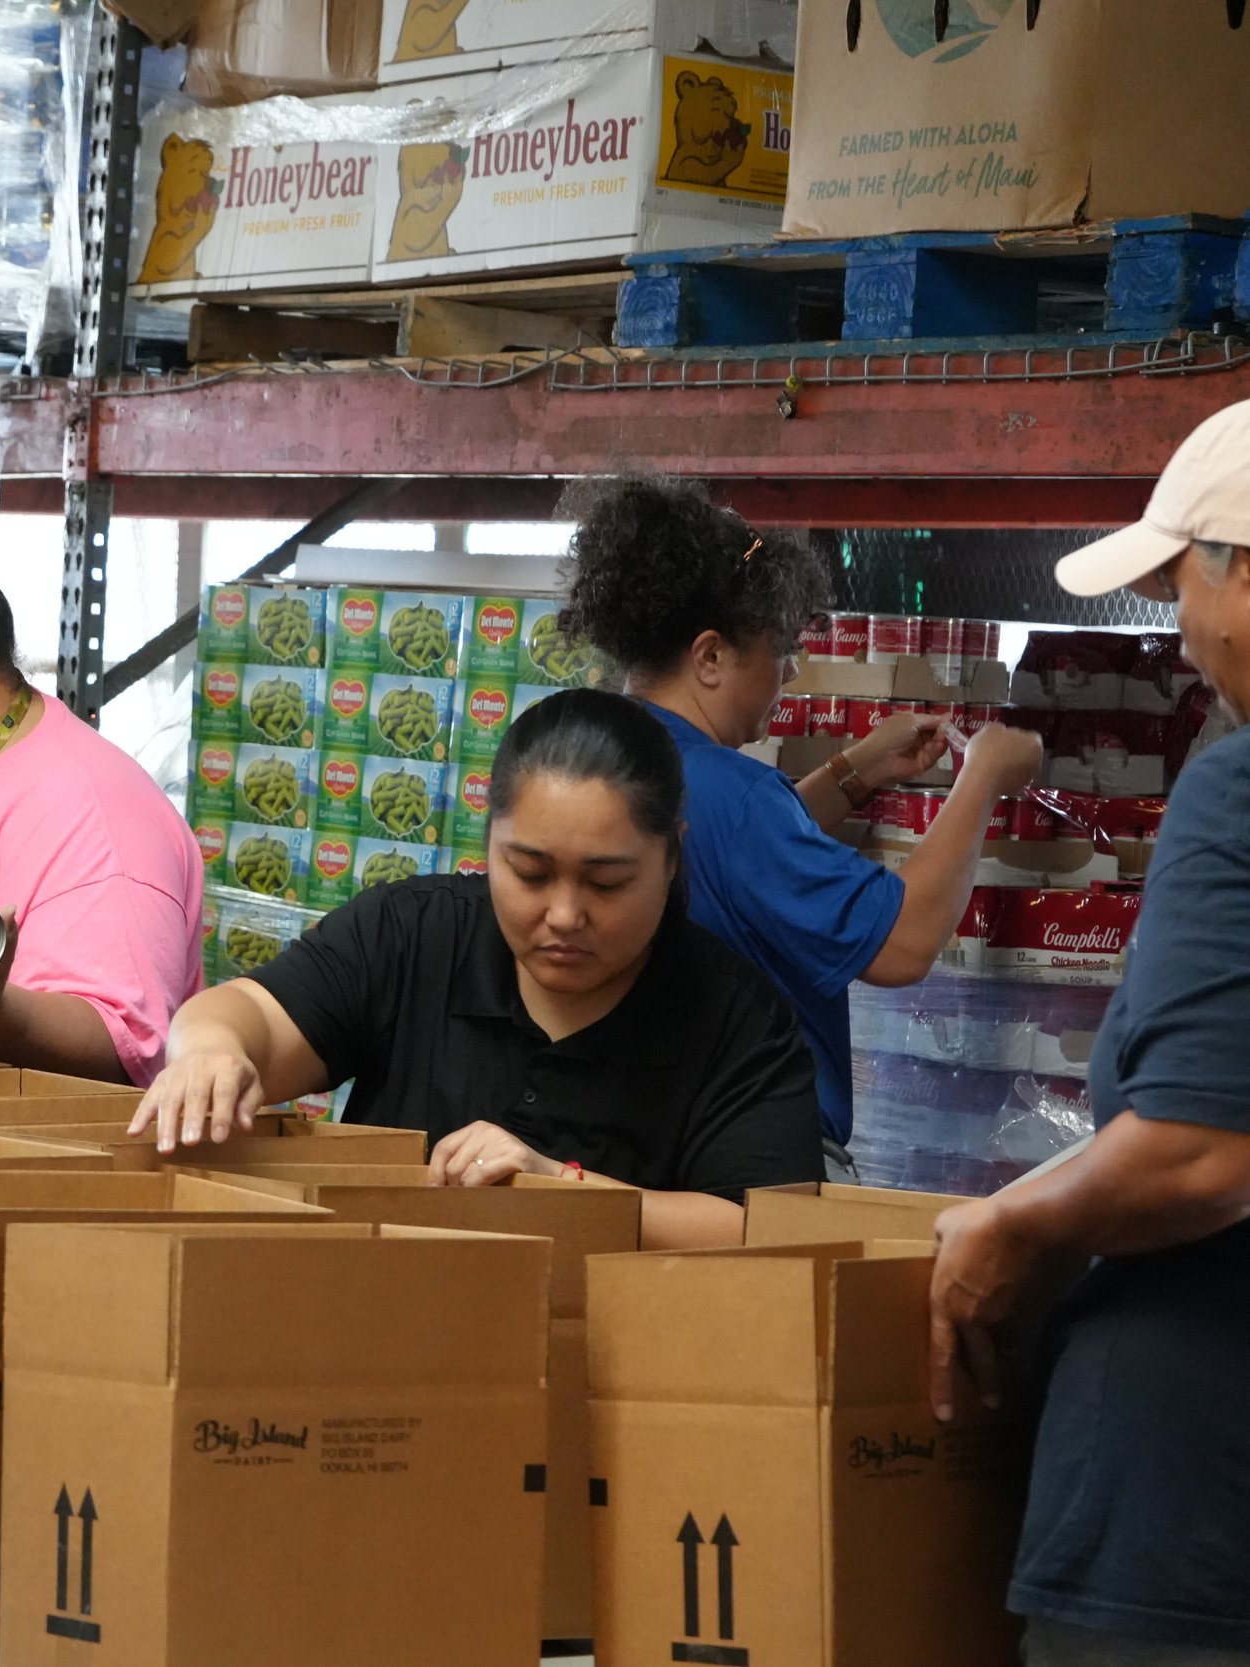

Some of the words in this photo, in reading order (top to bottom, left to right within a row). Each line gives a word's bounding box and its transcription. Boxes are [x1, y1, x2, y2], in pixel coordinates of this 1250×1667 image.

[471, 98, 637, 182] Honeybear
[839, 130, 903, 157] FARMED
[909, 126, 951, 149] WITH
[955, 121, 1018, 145] ALOHA
[224, 141, 372, 214] Honeybear
[807, 179, 851, 200] FROM
[857, 174, 886, 196] THE
[892, 159, 952, 210] Heart
[955, 157, 977, 190] of
[975, 151, 1040, 198] Maui
[493, 187, 546, 207] PREMIUM
[550, 182, 586, 200] FRESH
[590, 176, 627, 196] FRUIT
[294, 214, 327, 231] FRESH
[330, 212, 363, 228] FRUIT
[343, 607, 356, 619] Del
[356, 607, 375, 621] Monte
[481, 615, 493, 627] Del
[494, 614, 514, 629] Monte
[332, 689, 344, 700] Del
[345, 688, 364, 702] Monte
[472, 698, 483, 710] Del
[484, 697, 505, 712] Monte
[326, 768, 337, 780] Del
[338, 768, 356, 782] Monte
[465, 782, 476, 794] Del
[317, 848, 330, 861] Del
[330, 848, 348, 864] Monte
[1043, 922, 1121, 952] Campbell's
[1017, 951, 1026, 963] 12
[193, 1419, 240, 1454] Big
[241, 1417, 309, 1451] Island
[341, 1432, 378, 1443] ISLAND
[321, 1448, 337, 1458] PO
